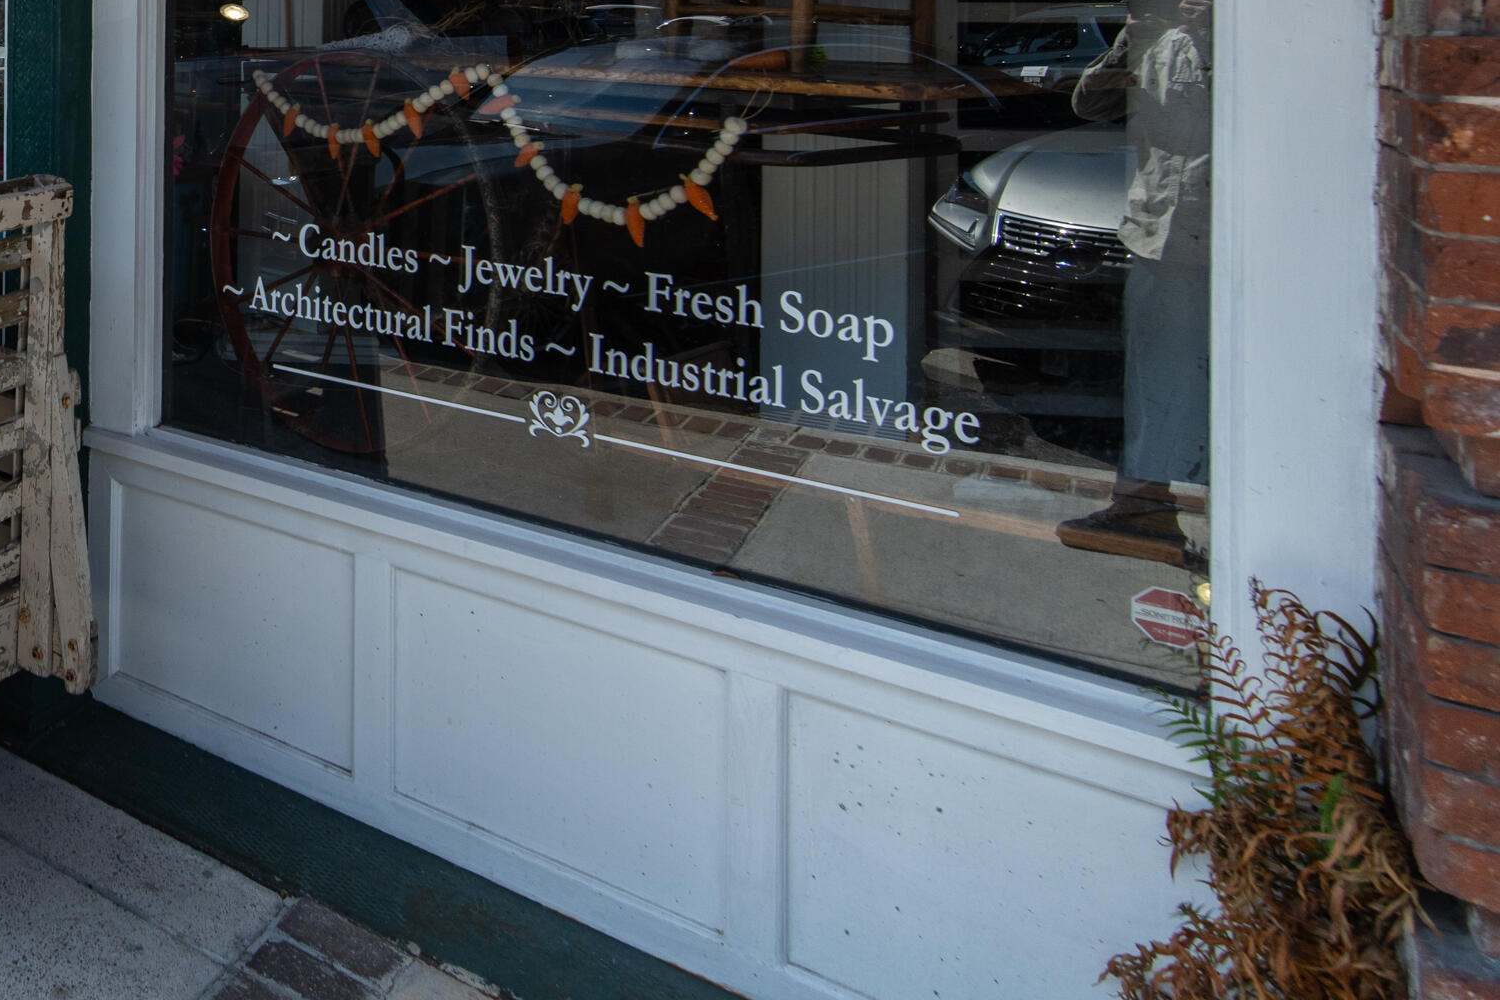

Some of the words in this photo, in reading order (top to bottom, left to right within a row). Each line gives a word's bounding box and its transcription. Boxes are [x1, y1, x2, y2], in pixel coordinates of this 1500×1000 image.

[248, 275, 433, 343] Architectural
[442, 307, 536, 362] Finds
[588, 332, 786, 409] Industrial
[800, 368, 982, 456] Salvage
[298, 222, 419, 275] Candles
[457, 244, 594, 312] Jewelry
[644, 271, 765, 329] Fresh
[779, 289, 895, 363] Soap
